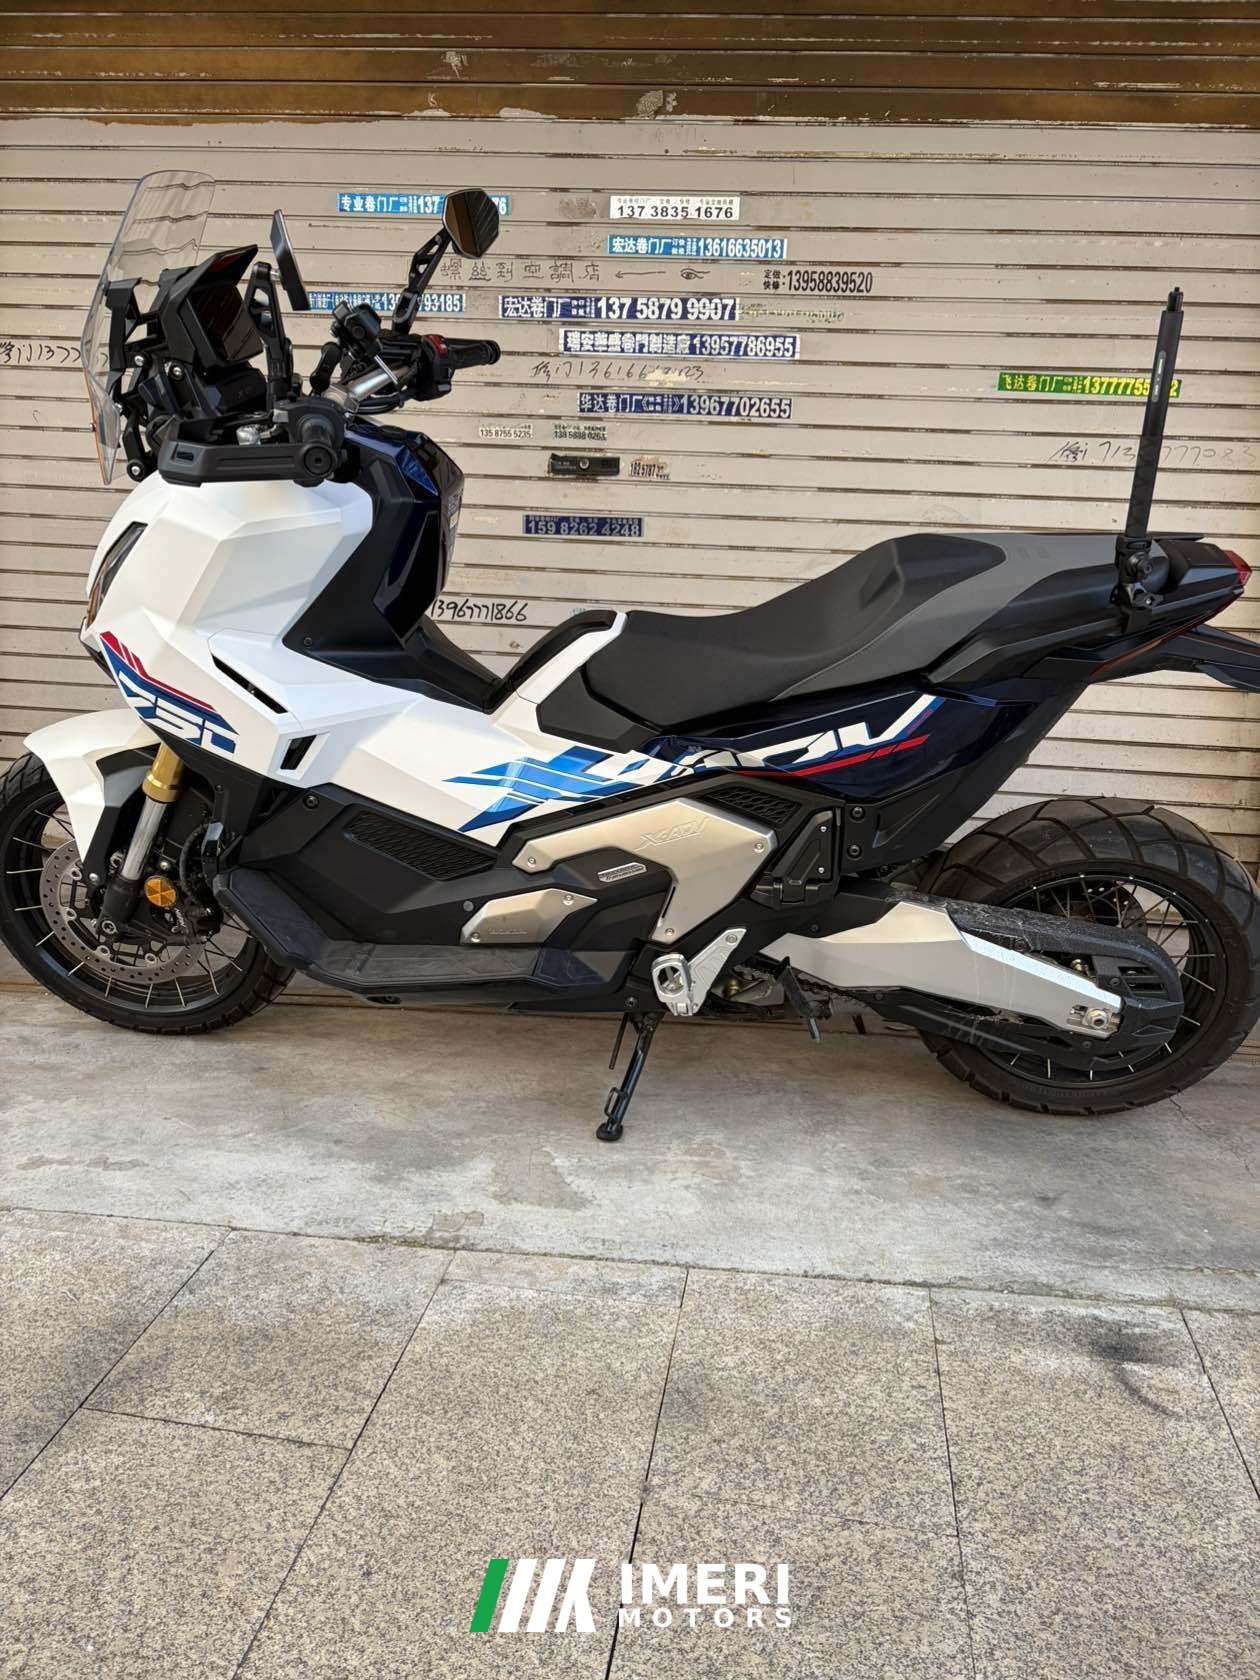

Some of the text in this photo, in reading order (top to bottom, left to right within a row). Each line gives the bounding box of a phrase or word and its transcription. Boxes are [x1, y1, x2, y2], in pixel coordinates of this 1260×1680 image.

[342, 195, 398, 213] 专业卷门厂
[617, 205, 734, 219] 137 3835 1676
[612, 236, 672, 254] 宏达卷门厂
[698, 237, 781, 258] 13616635013
[504, 296, 568, 318] 宏达卷门厂
[598, 297, 631, 319] 137
[637, 298, 681, 320] 5879
[687, 299, 732, 321] 9907
[694, 334, 794, 357] 13957786955
[1083, 376, 1178, 397] 137777552
[580, 393, 642, 413] 华达卷门厂
[681, 395, 790, 418] 13967702655
[529, 521, 639, 537] 159 8262 4248
